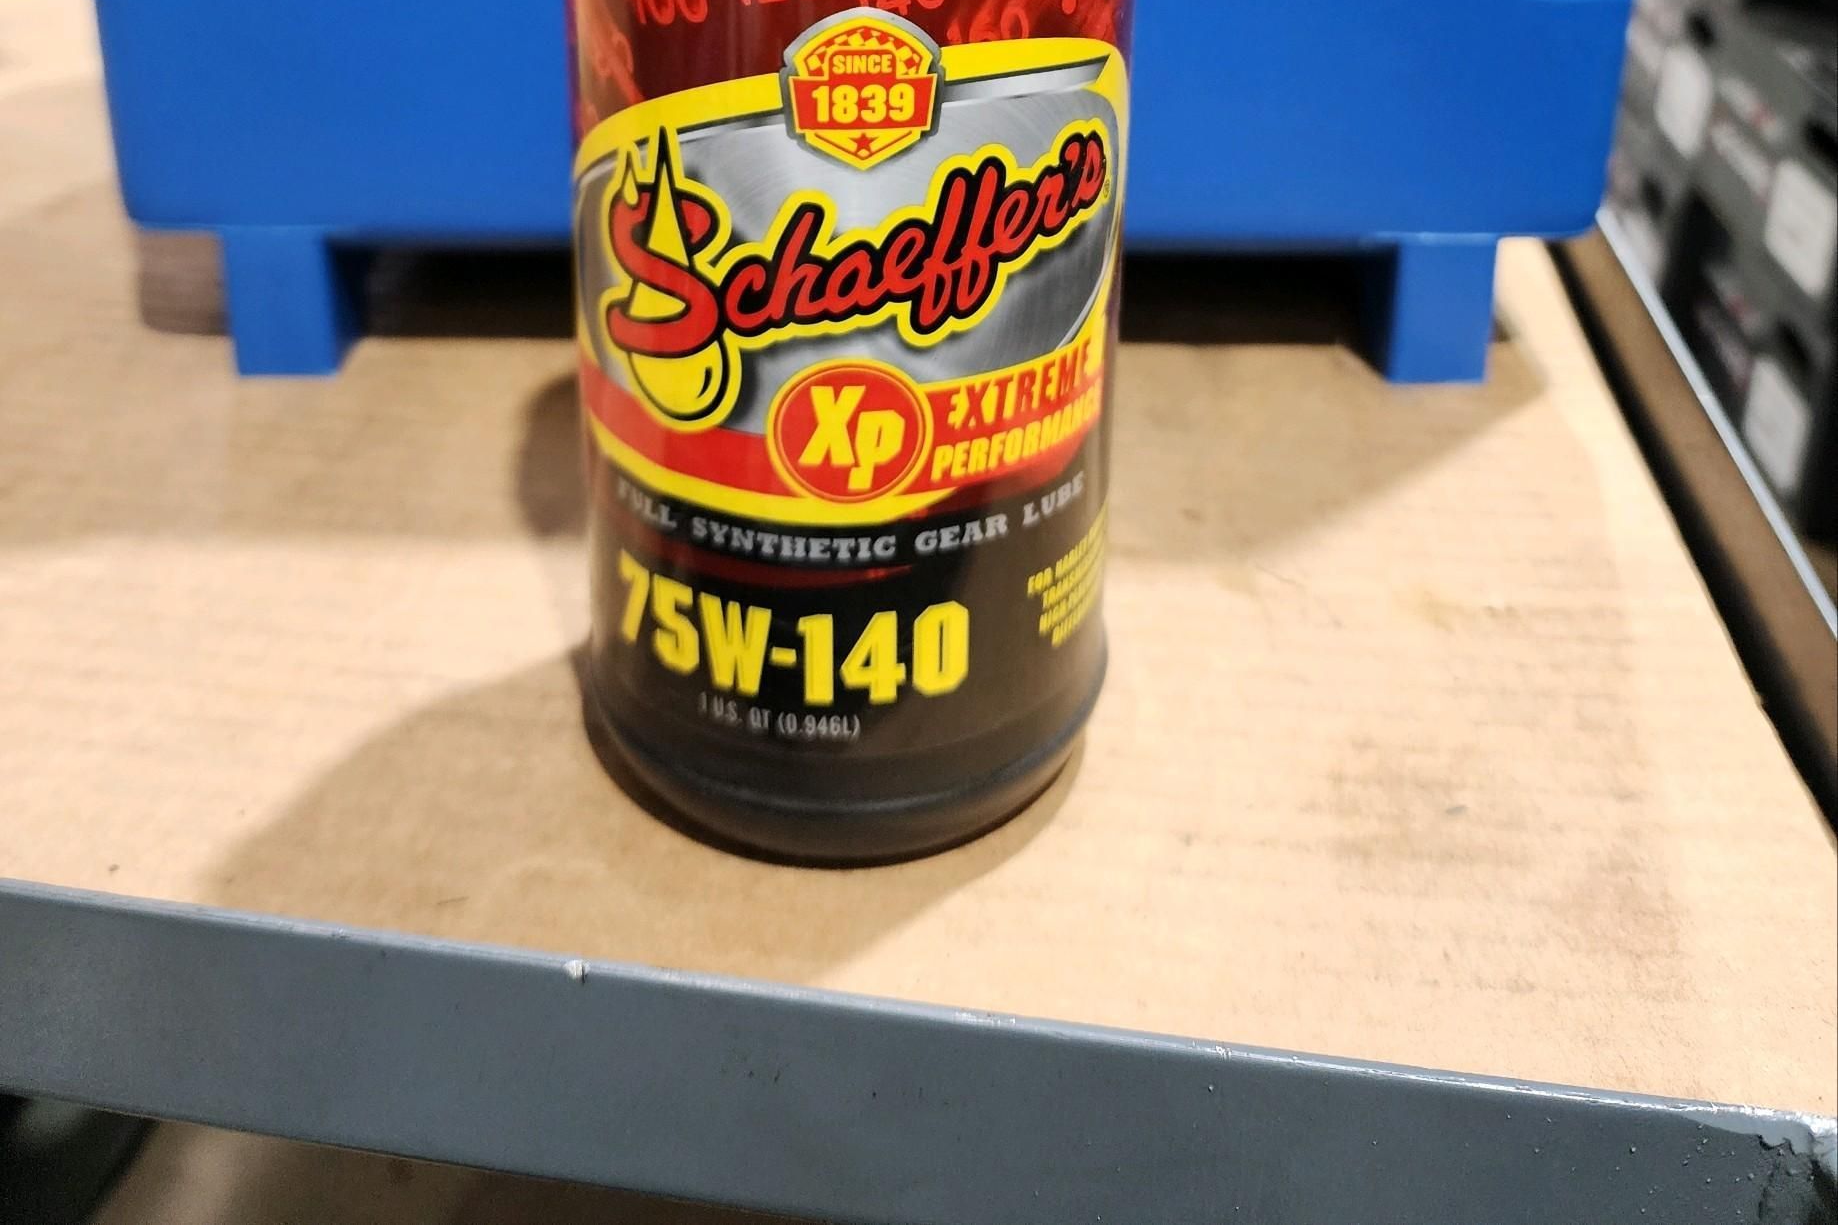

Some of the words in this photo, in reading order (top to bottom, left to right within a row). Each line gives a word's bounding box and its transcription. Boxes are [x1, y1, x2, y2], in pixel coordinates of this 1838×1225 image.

[812, 83, 916, 124] 1839
[832, 54, 893, 75] SINCE
[606, 135, 1106, 359] Schaeffer's
[946, 337, 1093, 430] EXTREME
[616, 476, 677, 529] FULL
[692, 516, 897, 560] SYNTHETIC
[914, 512, 1008, 552] GEAR
[1022, 471, 1084, 525] LUBE
[618, 548, 969, 706] 75W-140
[749, 706, 772, 730] QT
[777, 710, 862, 742] (0.946L)
